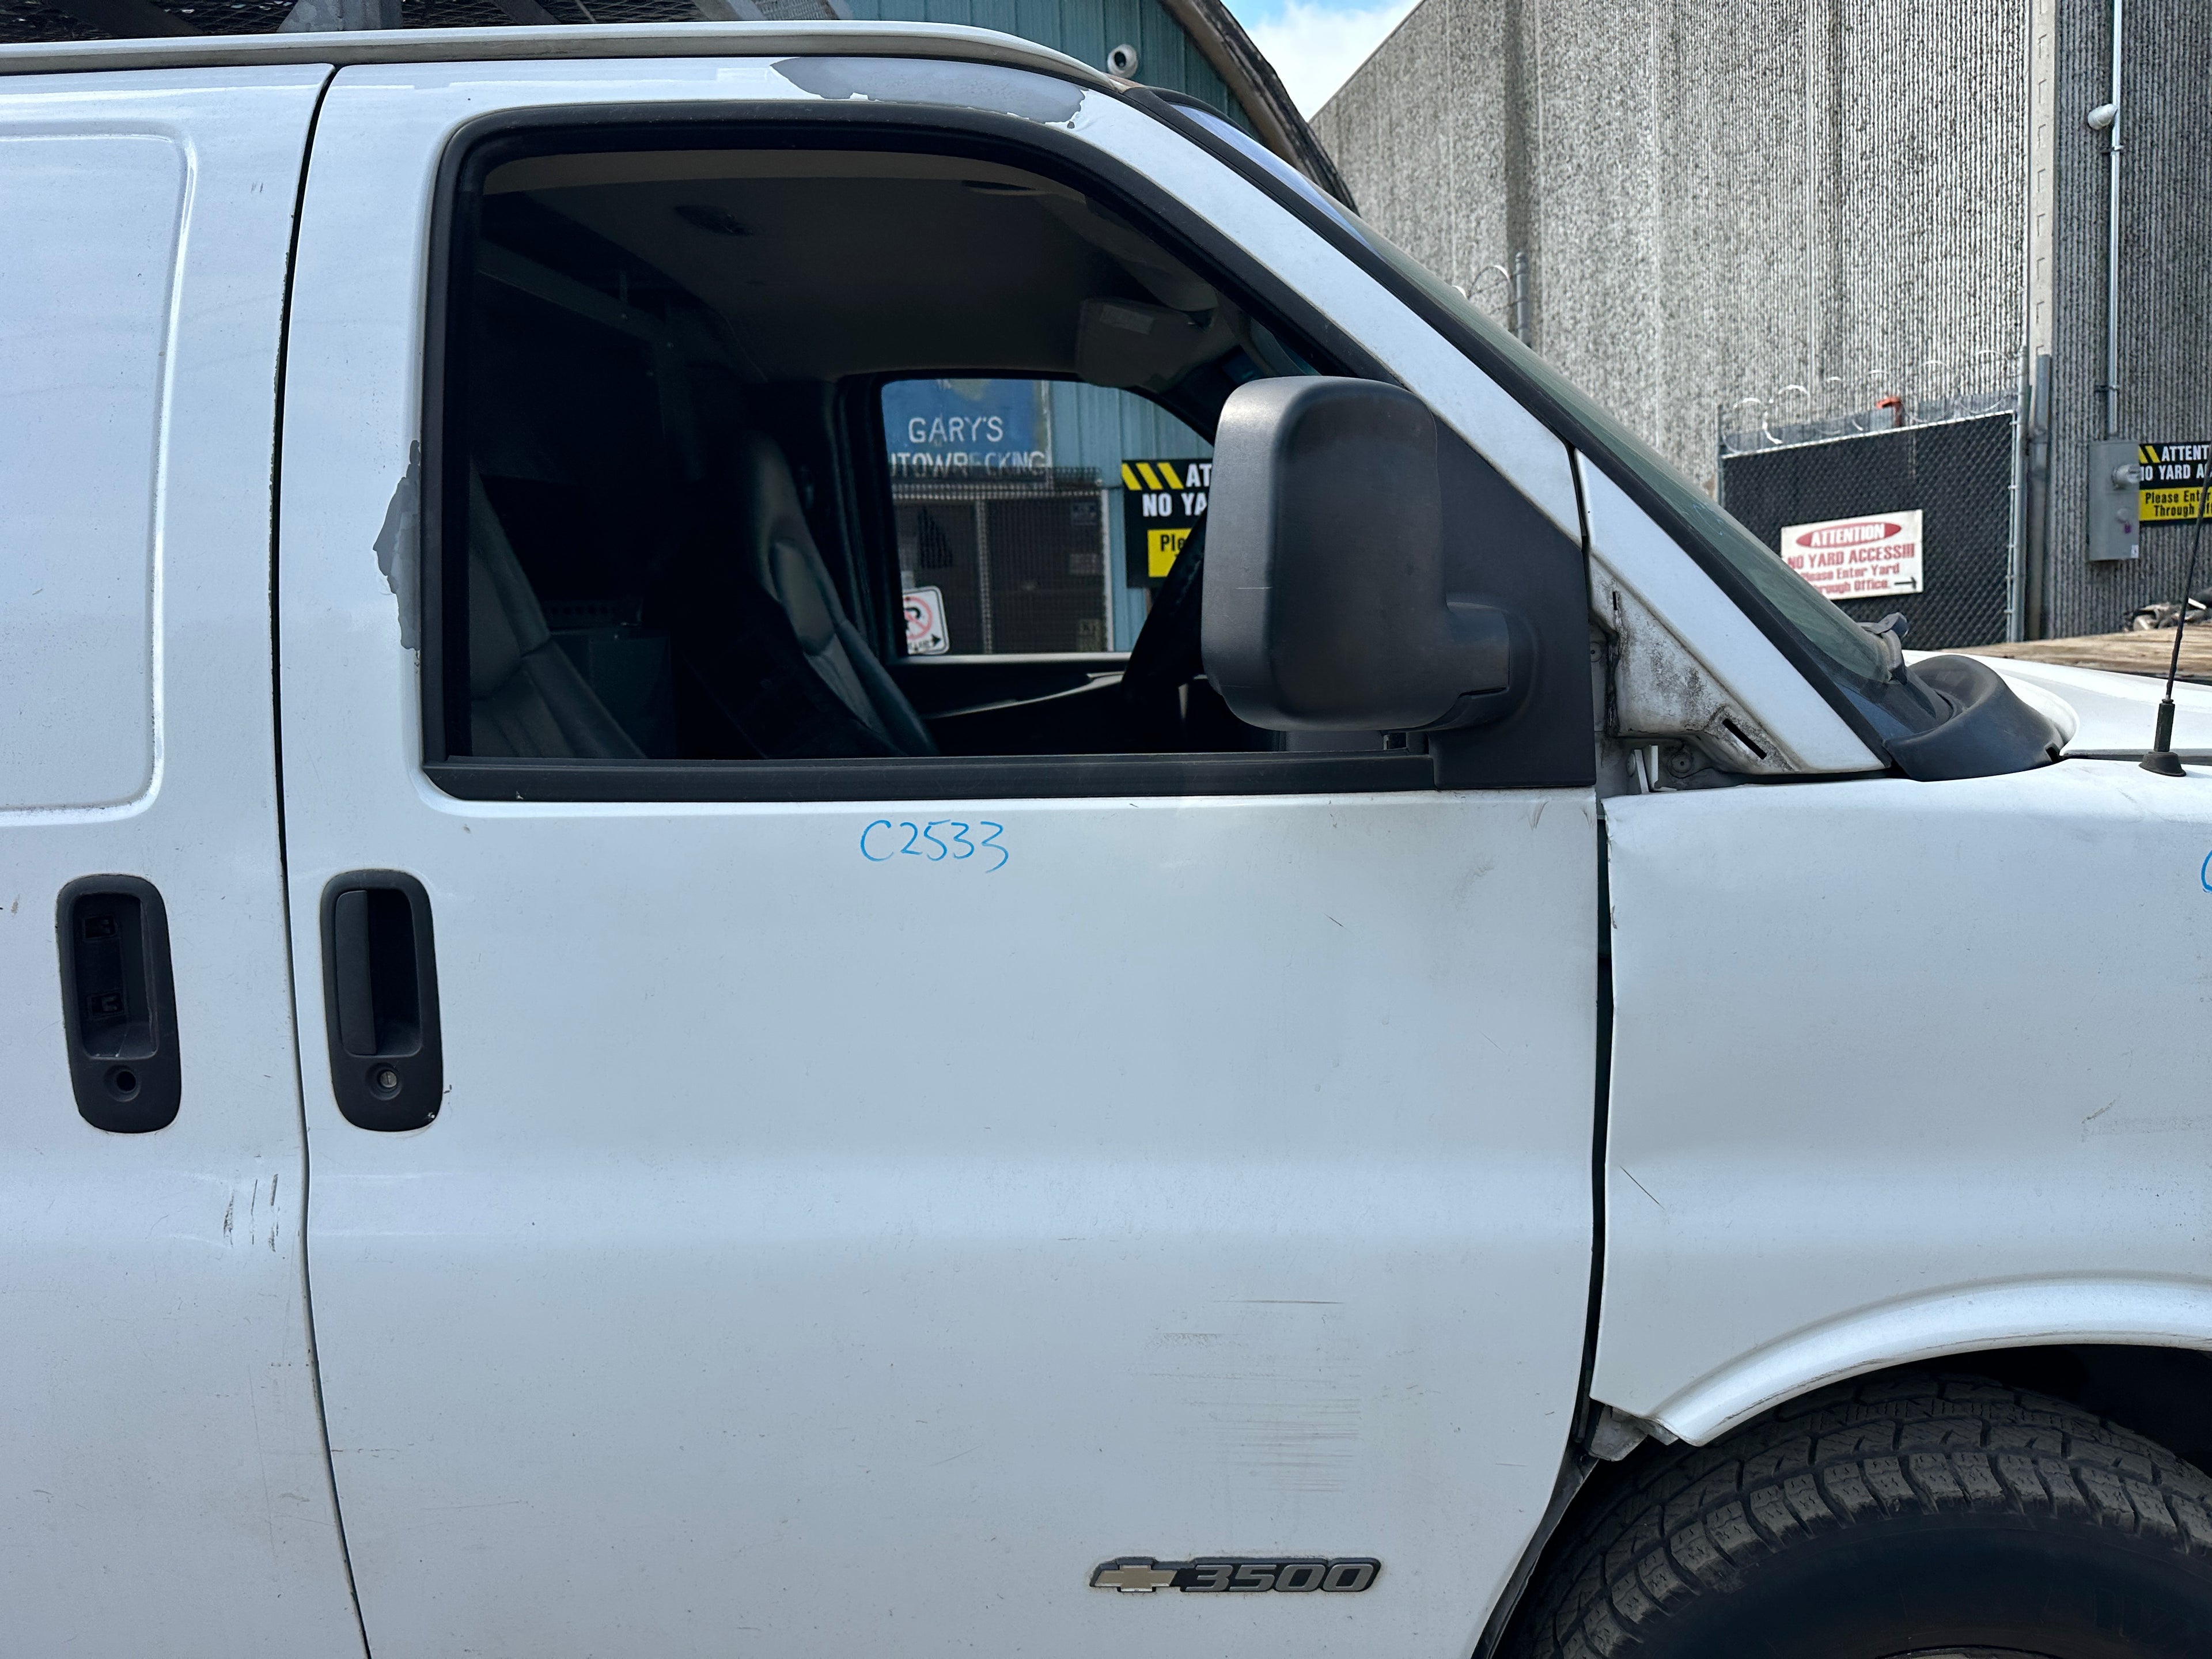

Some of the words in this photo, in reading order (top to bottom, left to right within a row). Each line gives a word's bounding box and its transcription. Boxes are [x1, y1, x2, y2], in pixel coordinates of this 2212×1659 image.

[908, 415, 1004, 444] GARY'S
[2161, 444, 2210, 461] ATTENT
[1185, 463, 1212, 487] AT
[2158, 464, 2191, 480] YARD
[1142, 493, 1173, 517] NO
[1181, 492, 1207, 516] YA
[2145, 491, 2179, 504] Please
[2184, 490, 2211, 502] Entr
[2154, 503, 2195, 517] Through
[1160, 533, 1186, 552] Ple
[1810, 522, 1885, 547] ATTENTION
[1787, 555, 1804, 569] NO
[1808, 551, 1844, 568] YARD
[1836, 566, 1868, 579] Enter
[1872, 562, 1900, 576] Yard
[860, 819, 1009, 874] C2533
[1184, 1563, 1377, 1592] 3500
